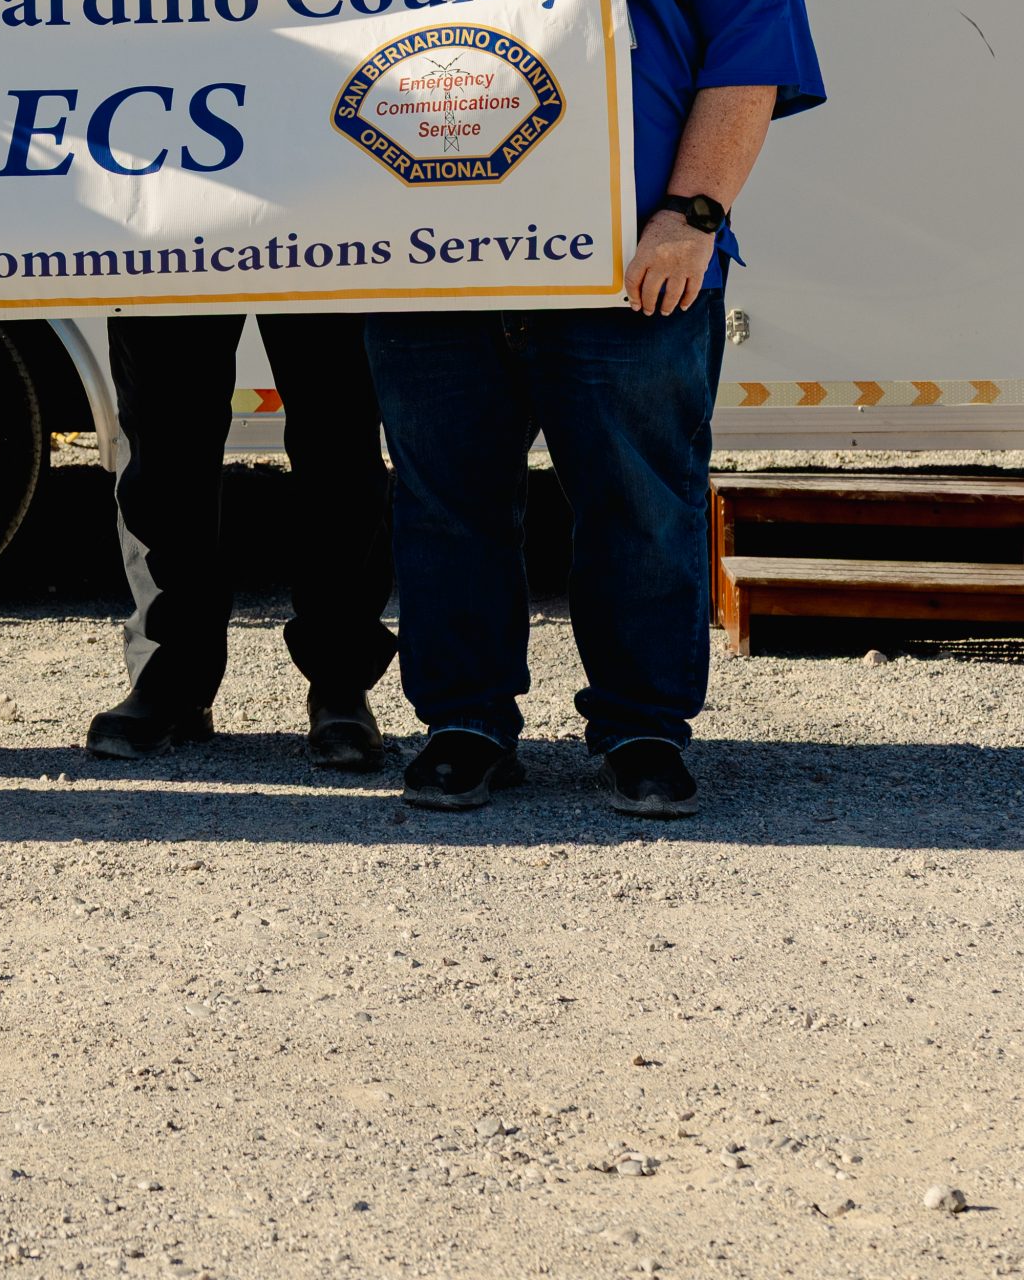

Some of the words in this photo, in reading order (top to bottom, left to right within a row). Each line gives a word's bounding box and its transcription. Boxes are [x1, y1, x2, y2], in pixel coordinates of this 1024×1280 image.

[338, 80, 368, 119] SAN
[365, 28, 490, 81] BERNARDINO
[494, 38, 561, 106] COUNTY
[399, 73, 495, 92] Emergency
[376, 94, 520, 116] Communications
[418, 121, 481, 138] Service
[359, 129, 499, 180] OPERATIONAL
[501, 115, 550, 164] AREA
[408, 224, 594, 265] Service
